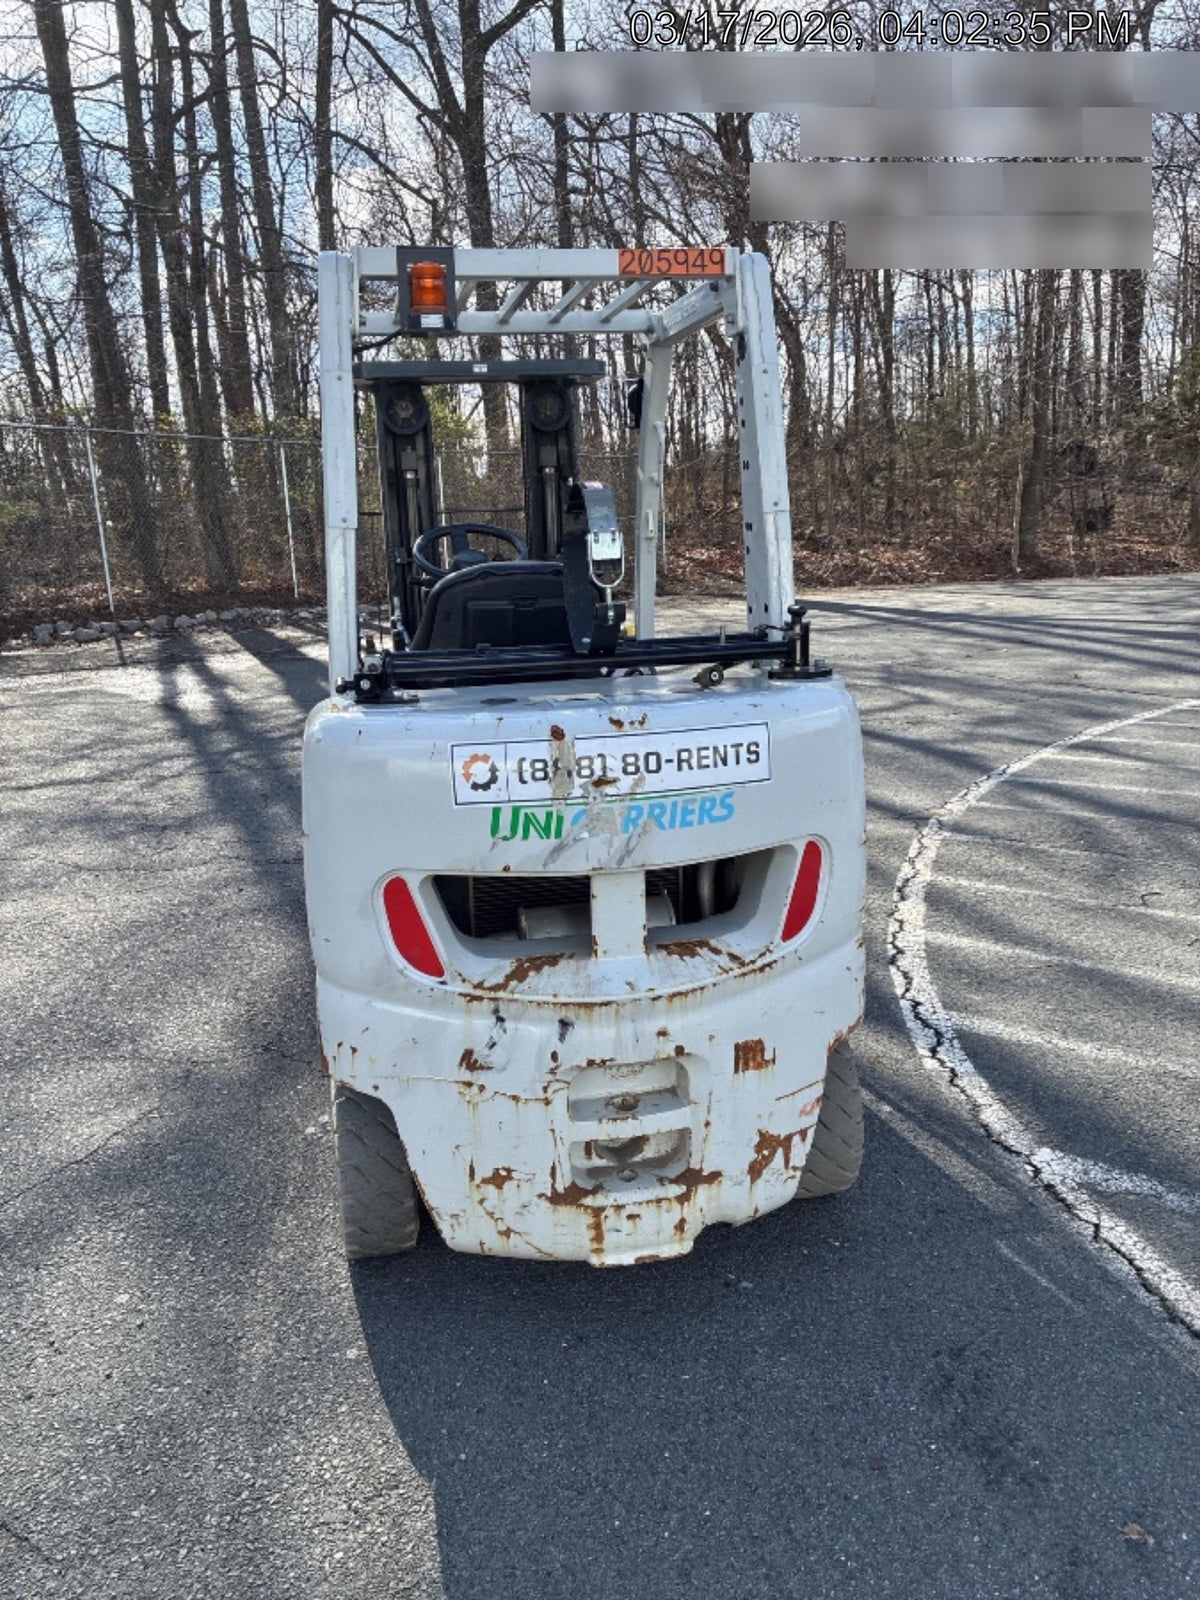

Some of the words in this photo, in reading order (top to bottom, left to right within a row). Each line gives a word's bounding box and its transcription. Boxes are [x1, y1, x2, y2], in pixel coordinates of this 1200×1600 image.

[620, 248, 725, 273] 205949
[621, 740, 761, 776] 80-RENTS
[489, 790, 735, 842] UNIRRIERS
